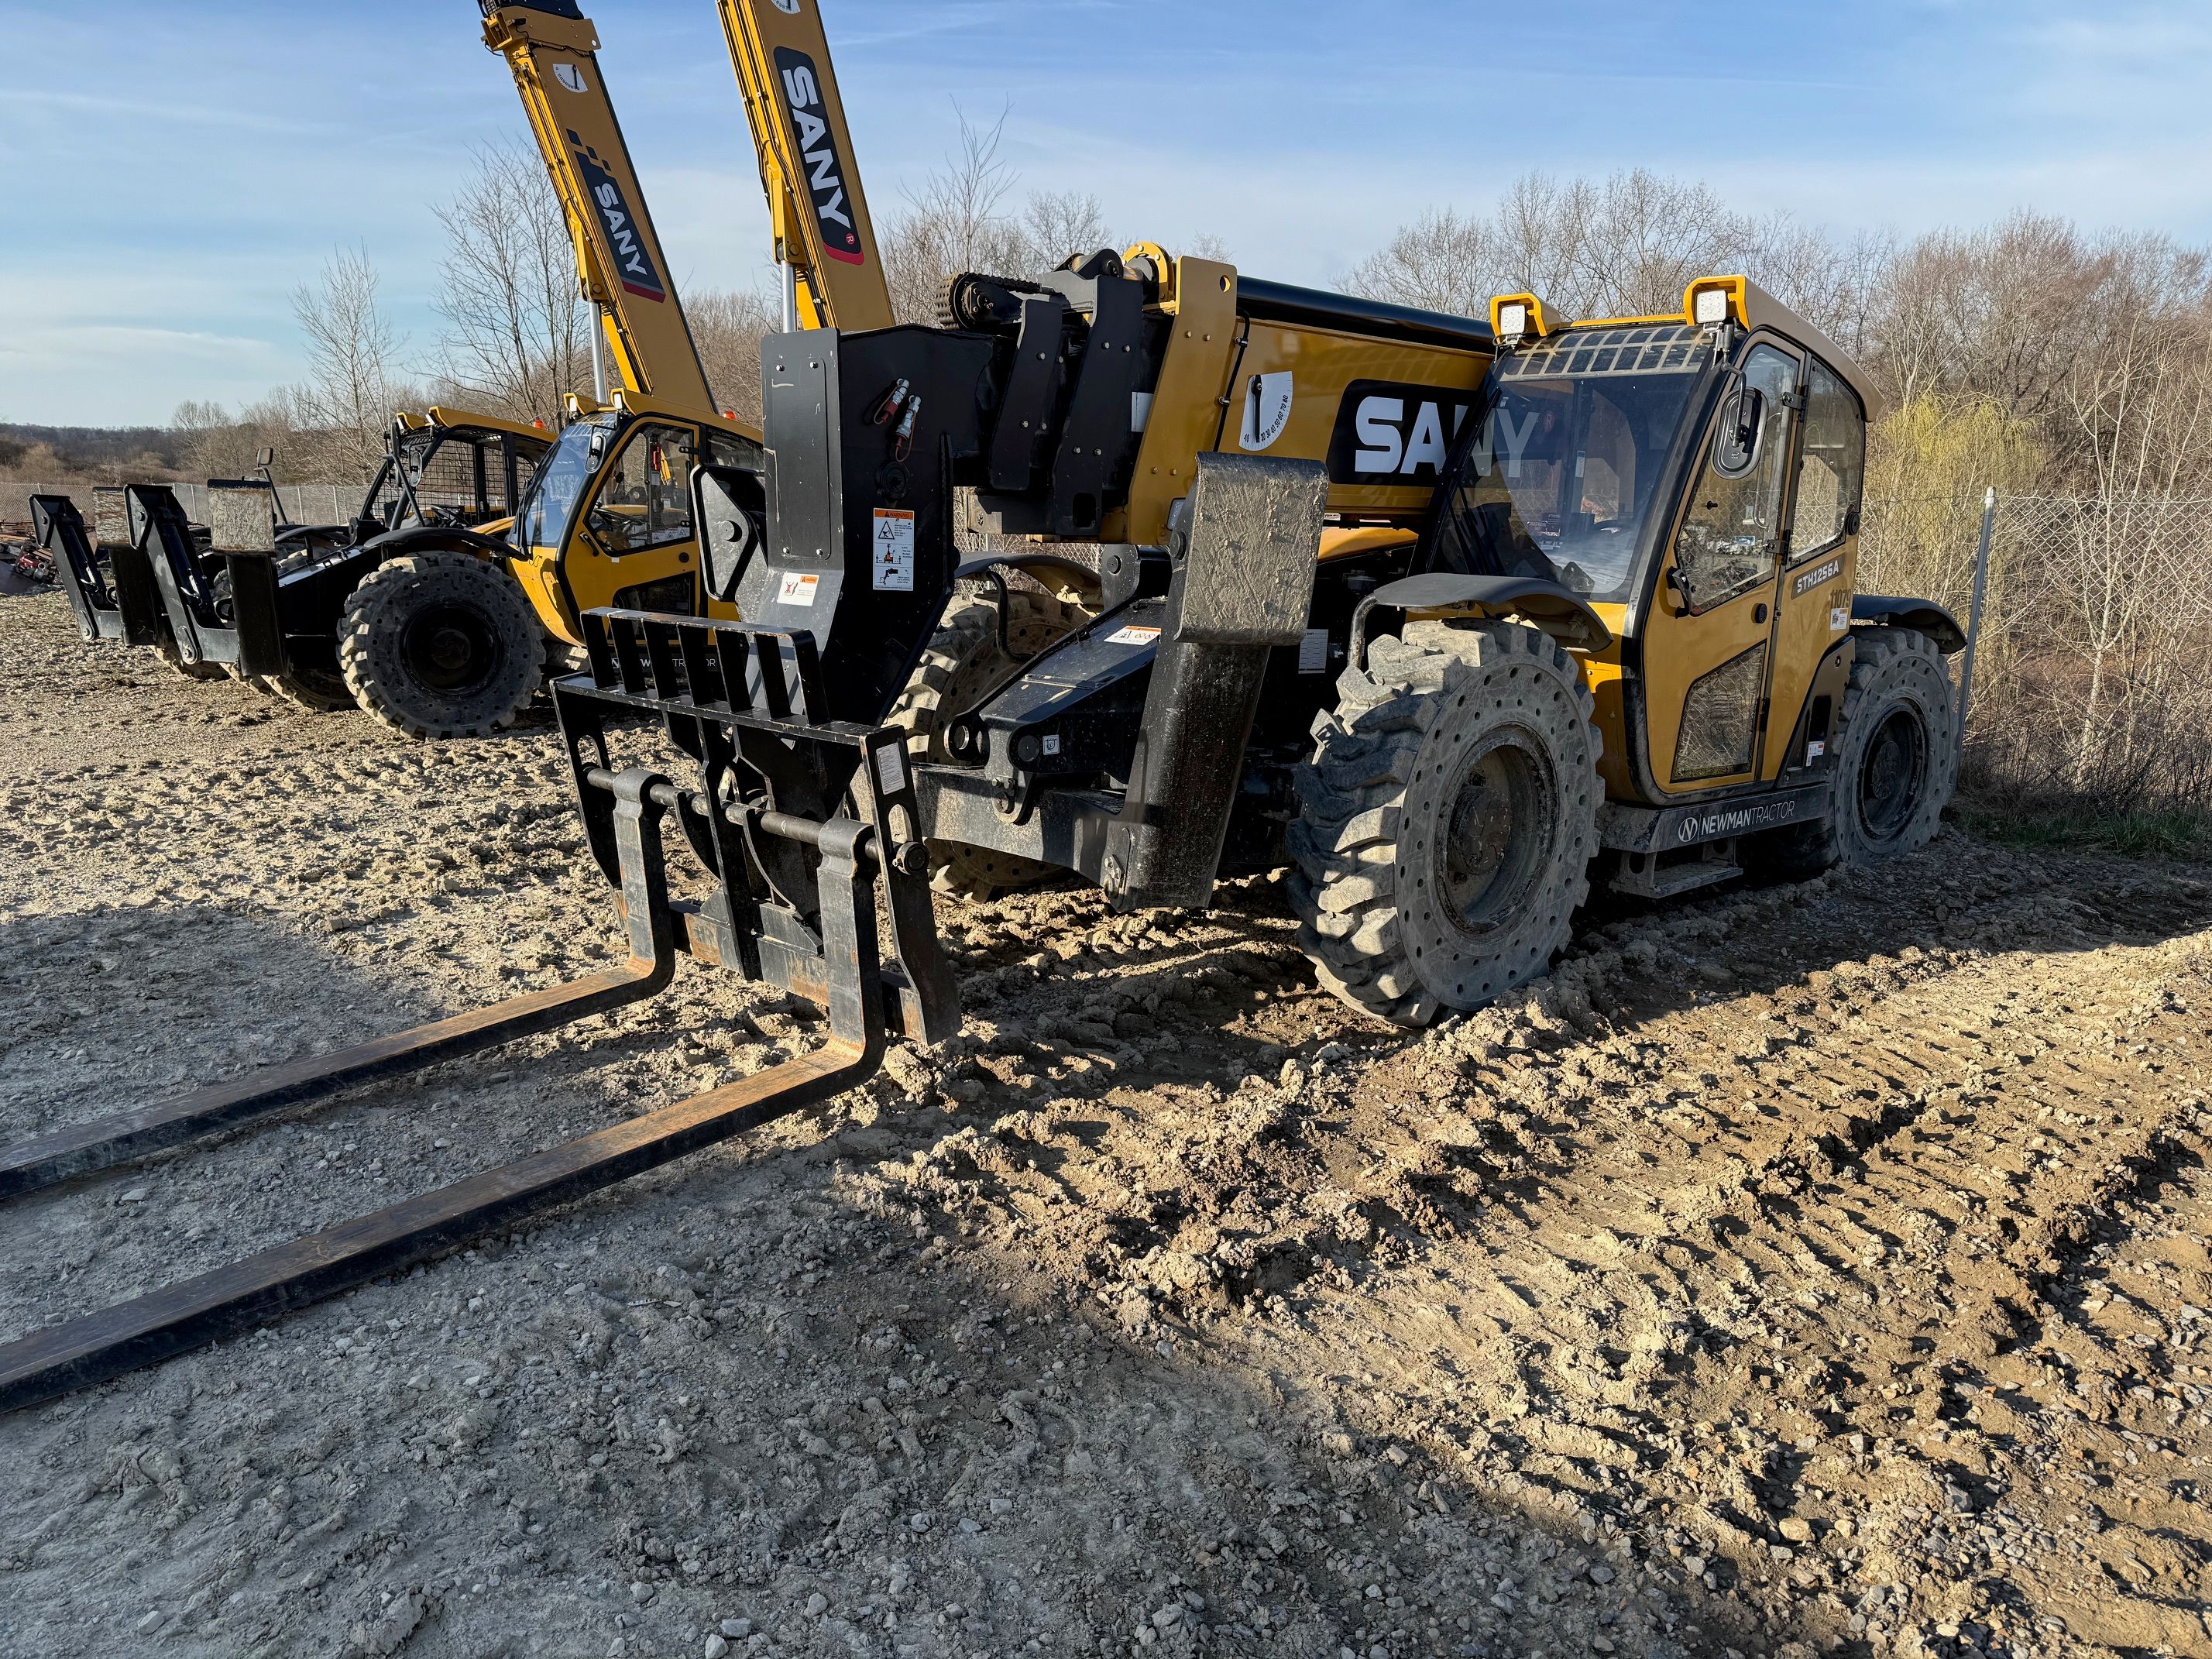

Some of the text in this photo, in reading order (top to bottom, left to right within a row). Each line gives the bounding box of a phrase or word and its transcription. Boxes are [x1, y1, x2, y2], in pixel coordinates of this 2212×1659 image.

[781, 65, 851, 229] SANY
[594, 183, 647, 276] SANY
[1282, 395, 1289, 404] 80
[1280, 403, 1286, 411] 70
[1274, 418, 1280, 428] 50
[1277, 411, 1284, 421] 60
[1260, 432, 1266, 441] 20
[1265, 428, 1271, 438] 30
[1355, 396, 1540, 478] SANY
[1797, 560, 1839, 593] STH1256A
[1830, 589, 1851, 608] 11079
[1701, 800, 1796, 836] NEWMANTRACTOR
